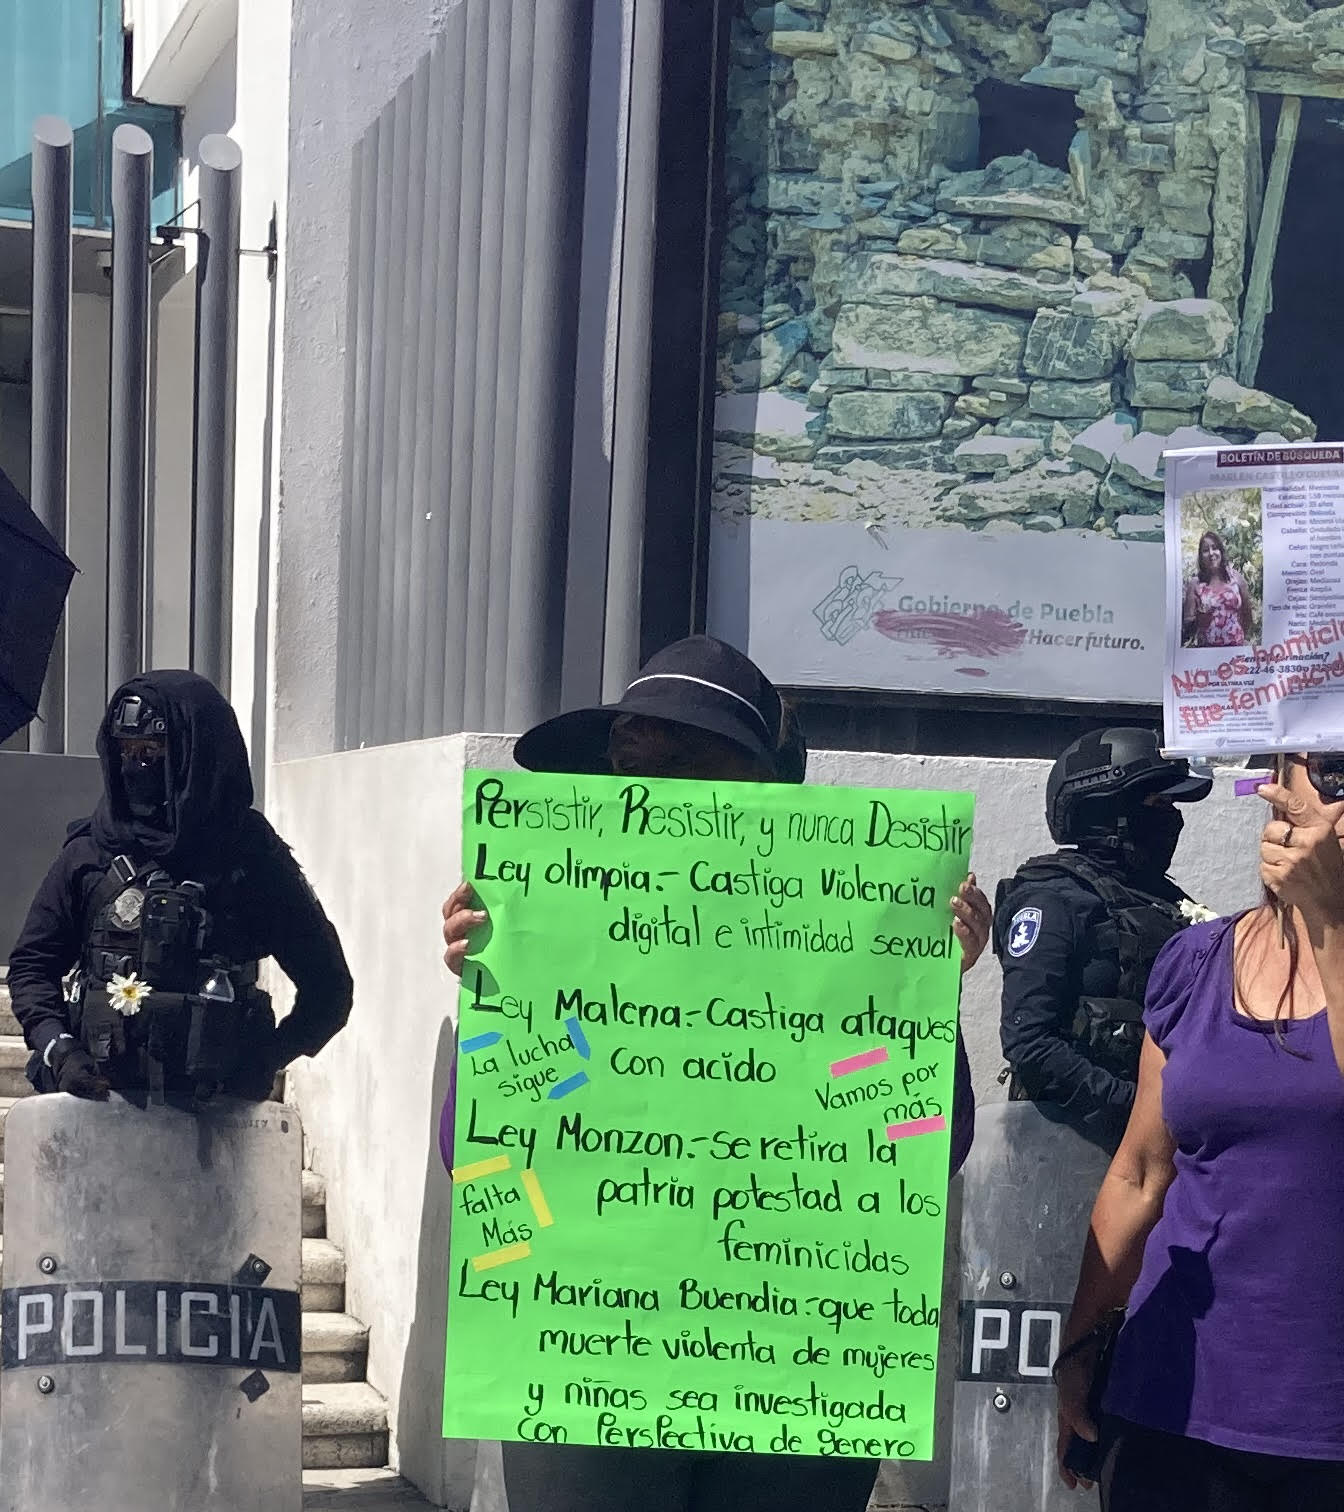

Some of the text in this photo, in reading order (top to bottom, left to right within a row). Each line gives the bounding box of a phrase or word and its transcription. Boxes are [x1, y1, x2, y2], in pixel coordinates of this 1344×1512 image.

[1266, 451, 1281, 462] DE
[1008, 598, 1034, 621] de
[1041, 603, 1114, 625] Puebla
[1029, 631, 1082, 649] Hacer
[865, 801, 971, 854] Desistir
[690, 861, 804, 908] Castiga
[609, 905, 953, 959] digital intimidad sexual
[707, 992, 955, 1058] Castiga ataques
[760, 1126, 847, 1163] retira
[598, 1168, 842, 1219] patria potestad
[718, 1220, 910, 1274] feminicidas
[534, 1271, 659, 1311] Mariana
[18, 1289, 286, 1363] POLICIA
[539, 1320, 934, 1377] muerte violenta mujeres
[735, 1382, 906, 1432] investigada
